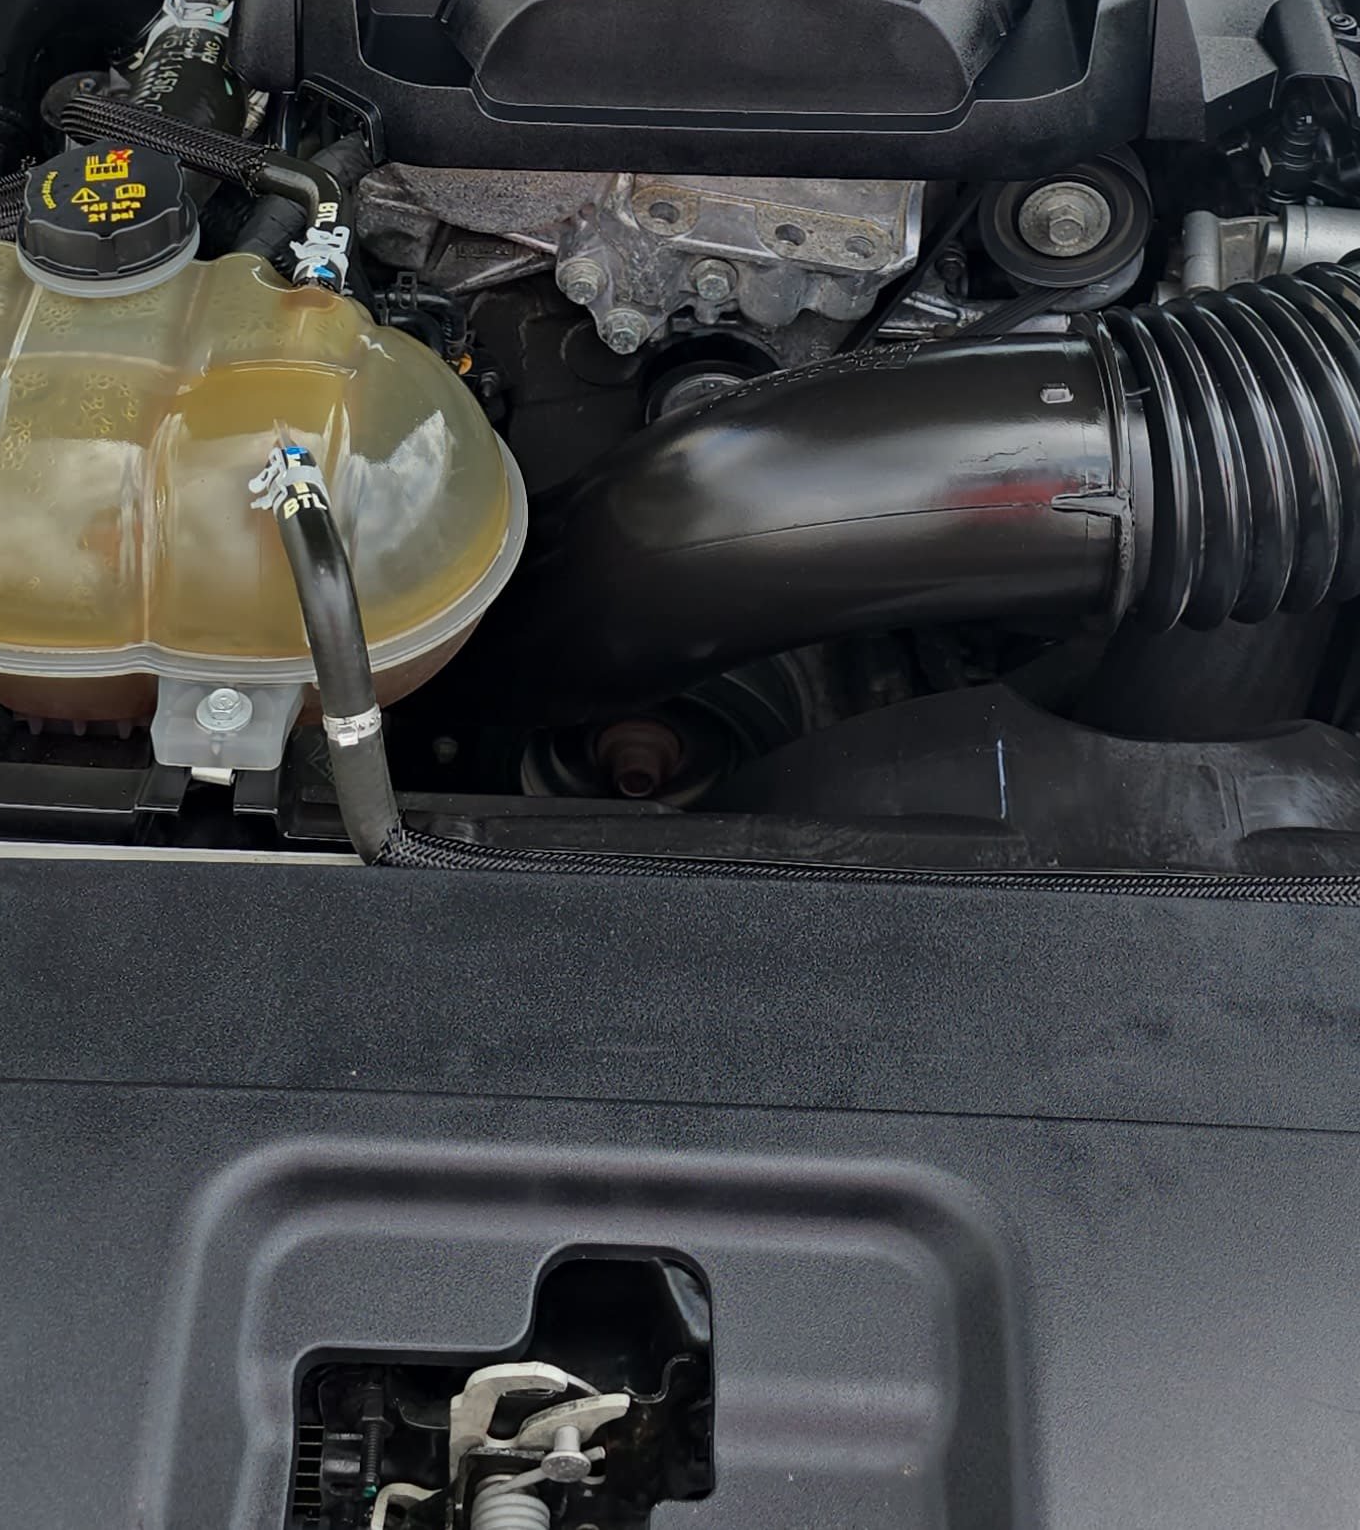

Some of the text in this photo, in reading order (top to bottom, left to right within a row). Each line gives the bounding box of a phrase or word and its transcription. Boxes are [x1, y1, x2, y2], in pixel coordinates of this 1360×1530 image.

[200, 41, 221, 64] ENG
[80, 200, 141, 213] 145 kPa
[88, 210, 135, 223] 21 psi
[315, 202, 338, 227] BTL
[283, 492, 328, 519] BTL
